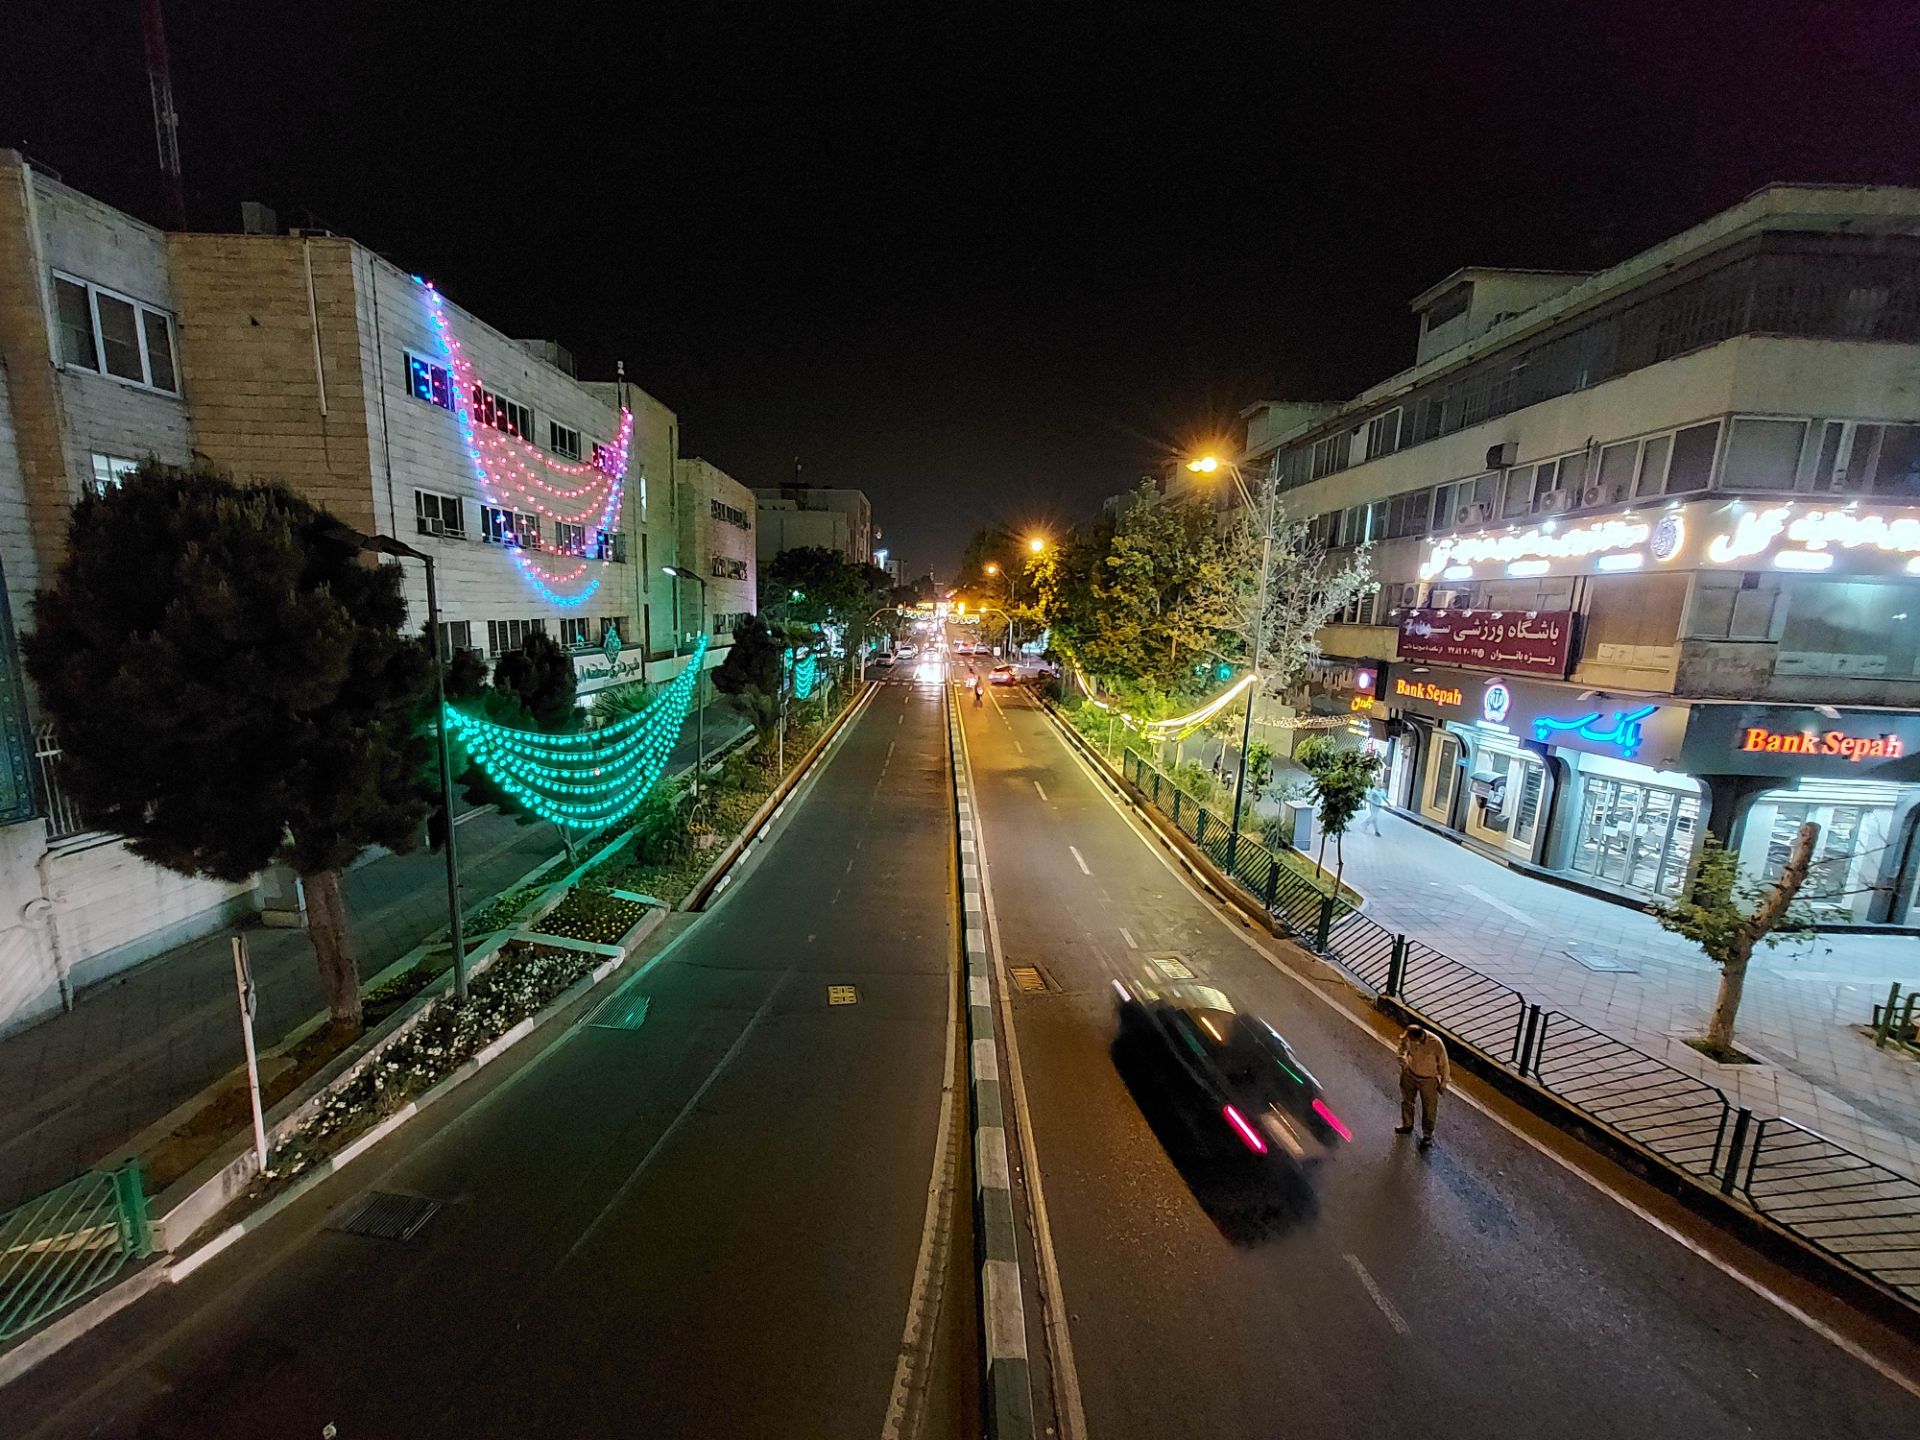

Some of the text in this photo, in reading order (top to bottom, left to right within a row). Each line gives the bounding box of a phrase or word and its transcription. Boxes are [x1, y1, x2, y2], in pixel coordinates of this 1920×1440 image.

[1453, 618, 1505, 642] ورزشی
[1508, 618, 1560, 646] باشگاه
[1490, 649, 1523, 663] بانوان
[1395, 678, 1463, 706] Bank Sepah
[1534, 705, 1656, 757] بانک سپه
[1742, 727, 1904, 762] Bank Sepah
